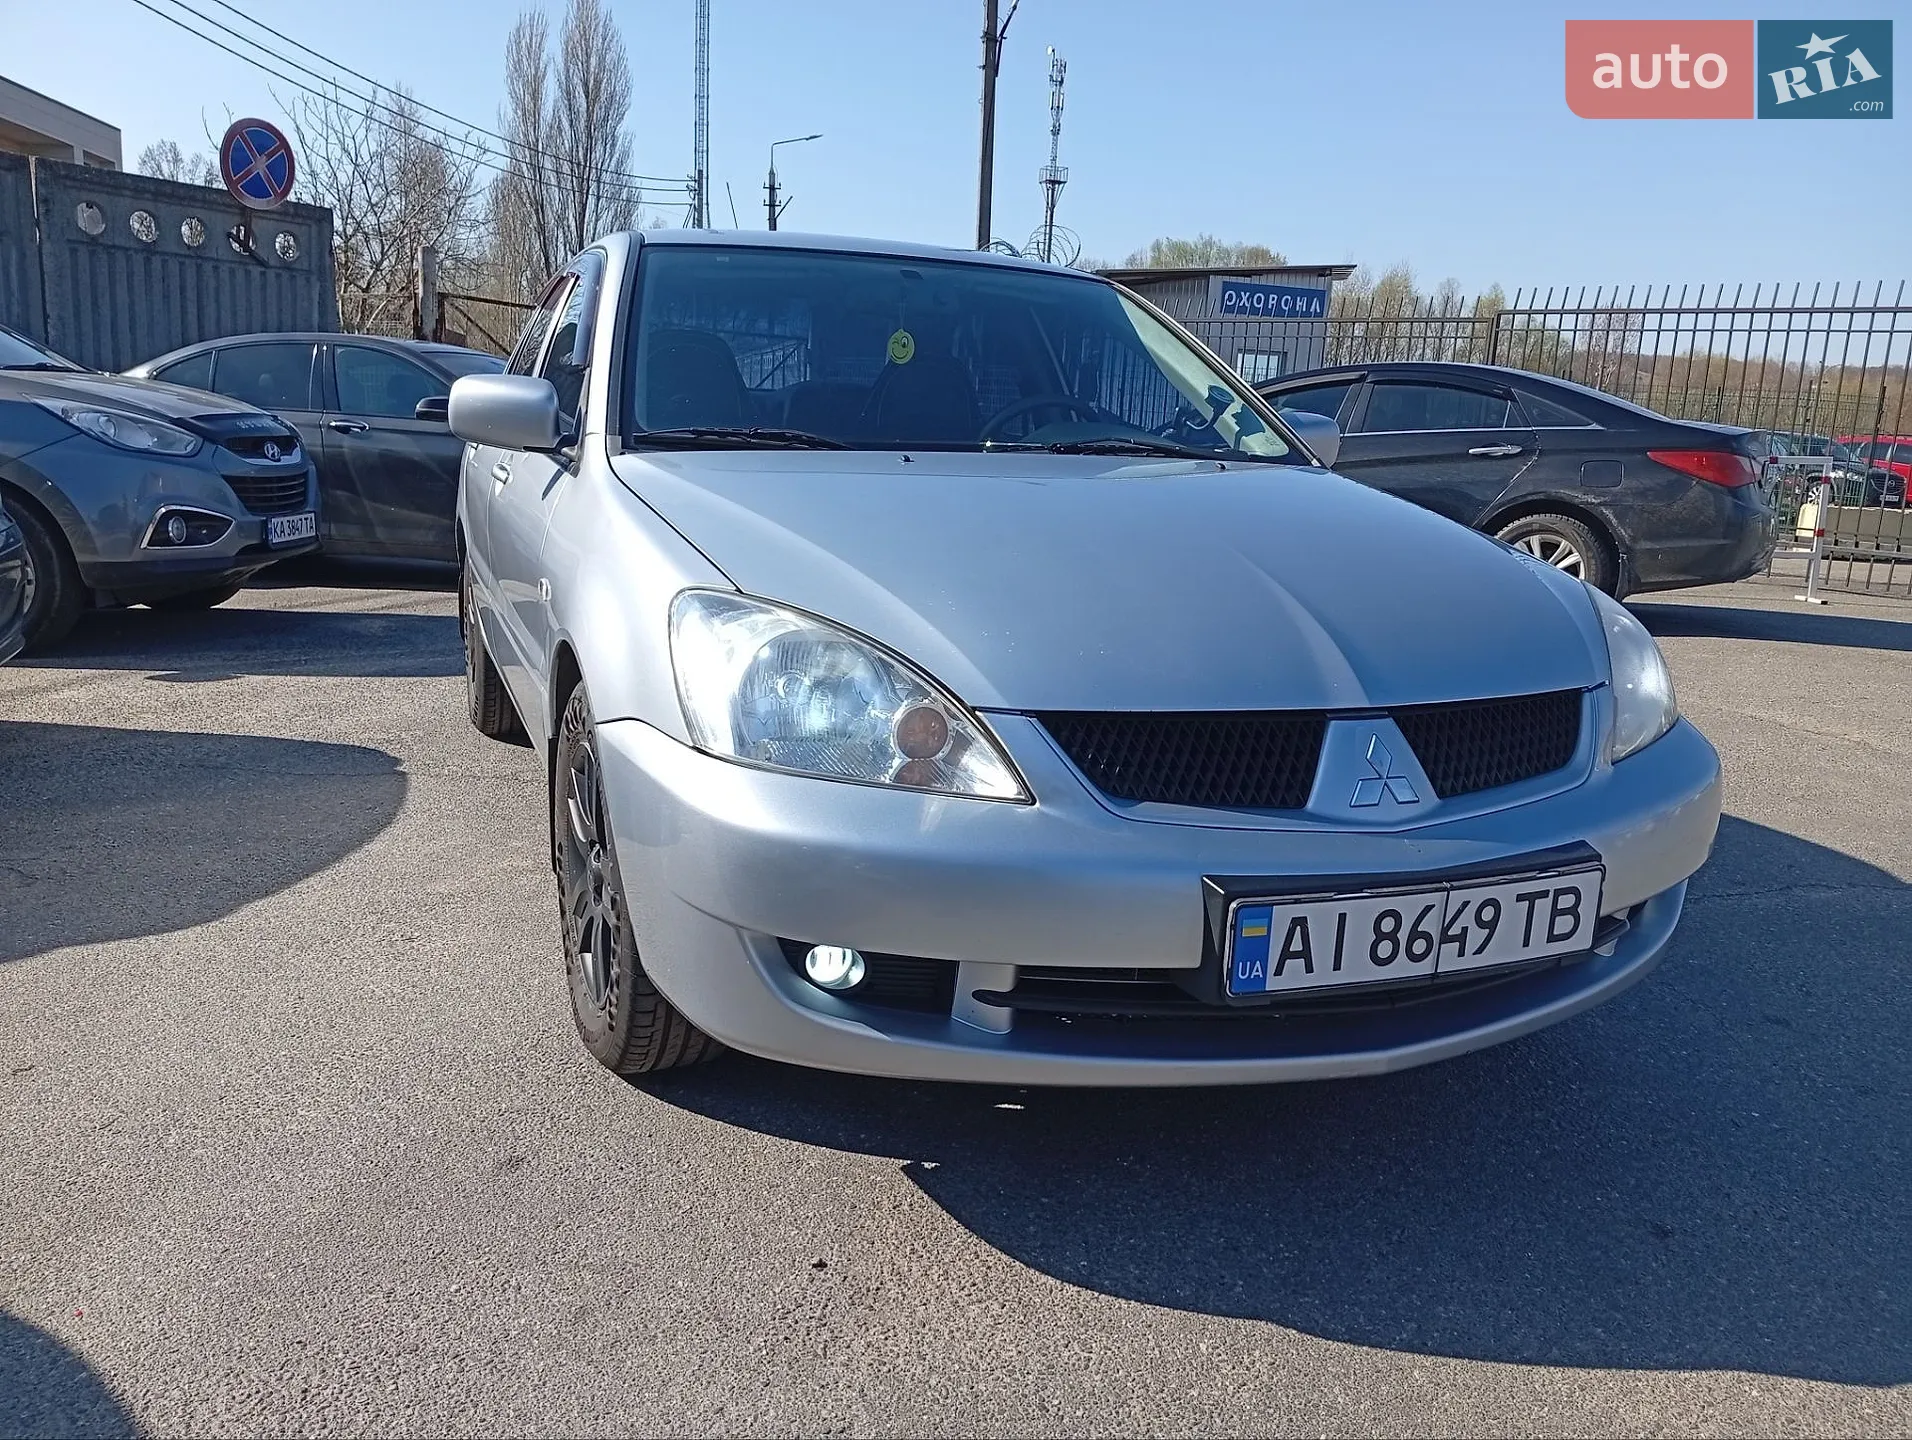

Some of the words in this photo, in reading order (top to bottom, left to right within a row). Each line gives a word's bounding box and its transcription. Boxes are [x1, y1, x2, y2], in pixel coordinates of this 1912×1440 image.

[273, 518, 286, 539] KA
[287, 517, 304, 537] 3847
[303, 516, 314, 535] TA
[1272, 912, 1347, 977] AI
[1369, 898, 1501, 967] 8649
[1515, 886, 1581, 948] TB
[1238, 961, 1263, 980] UA
